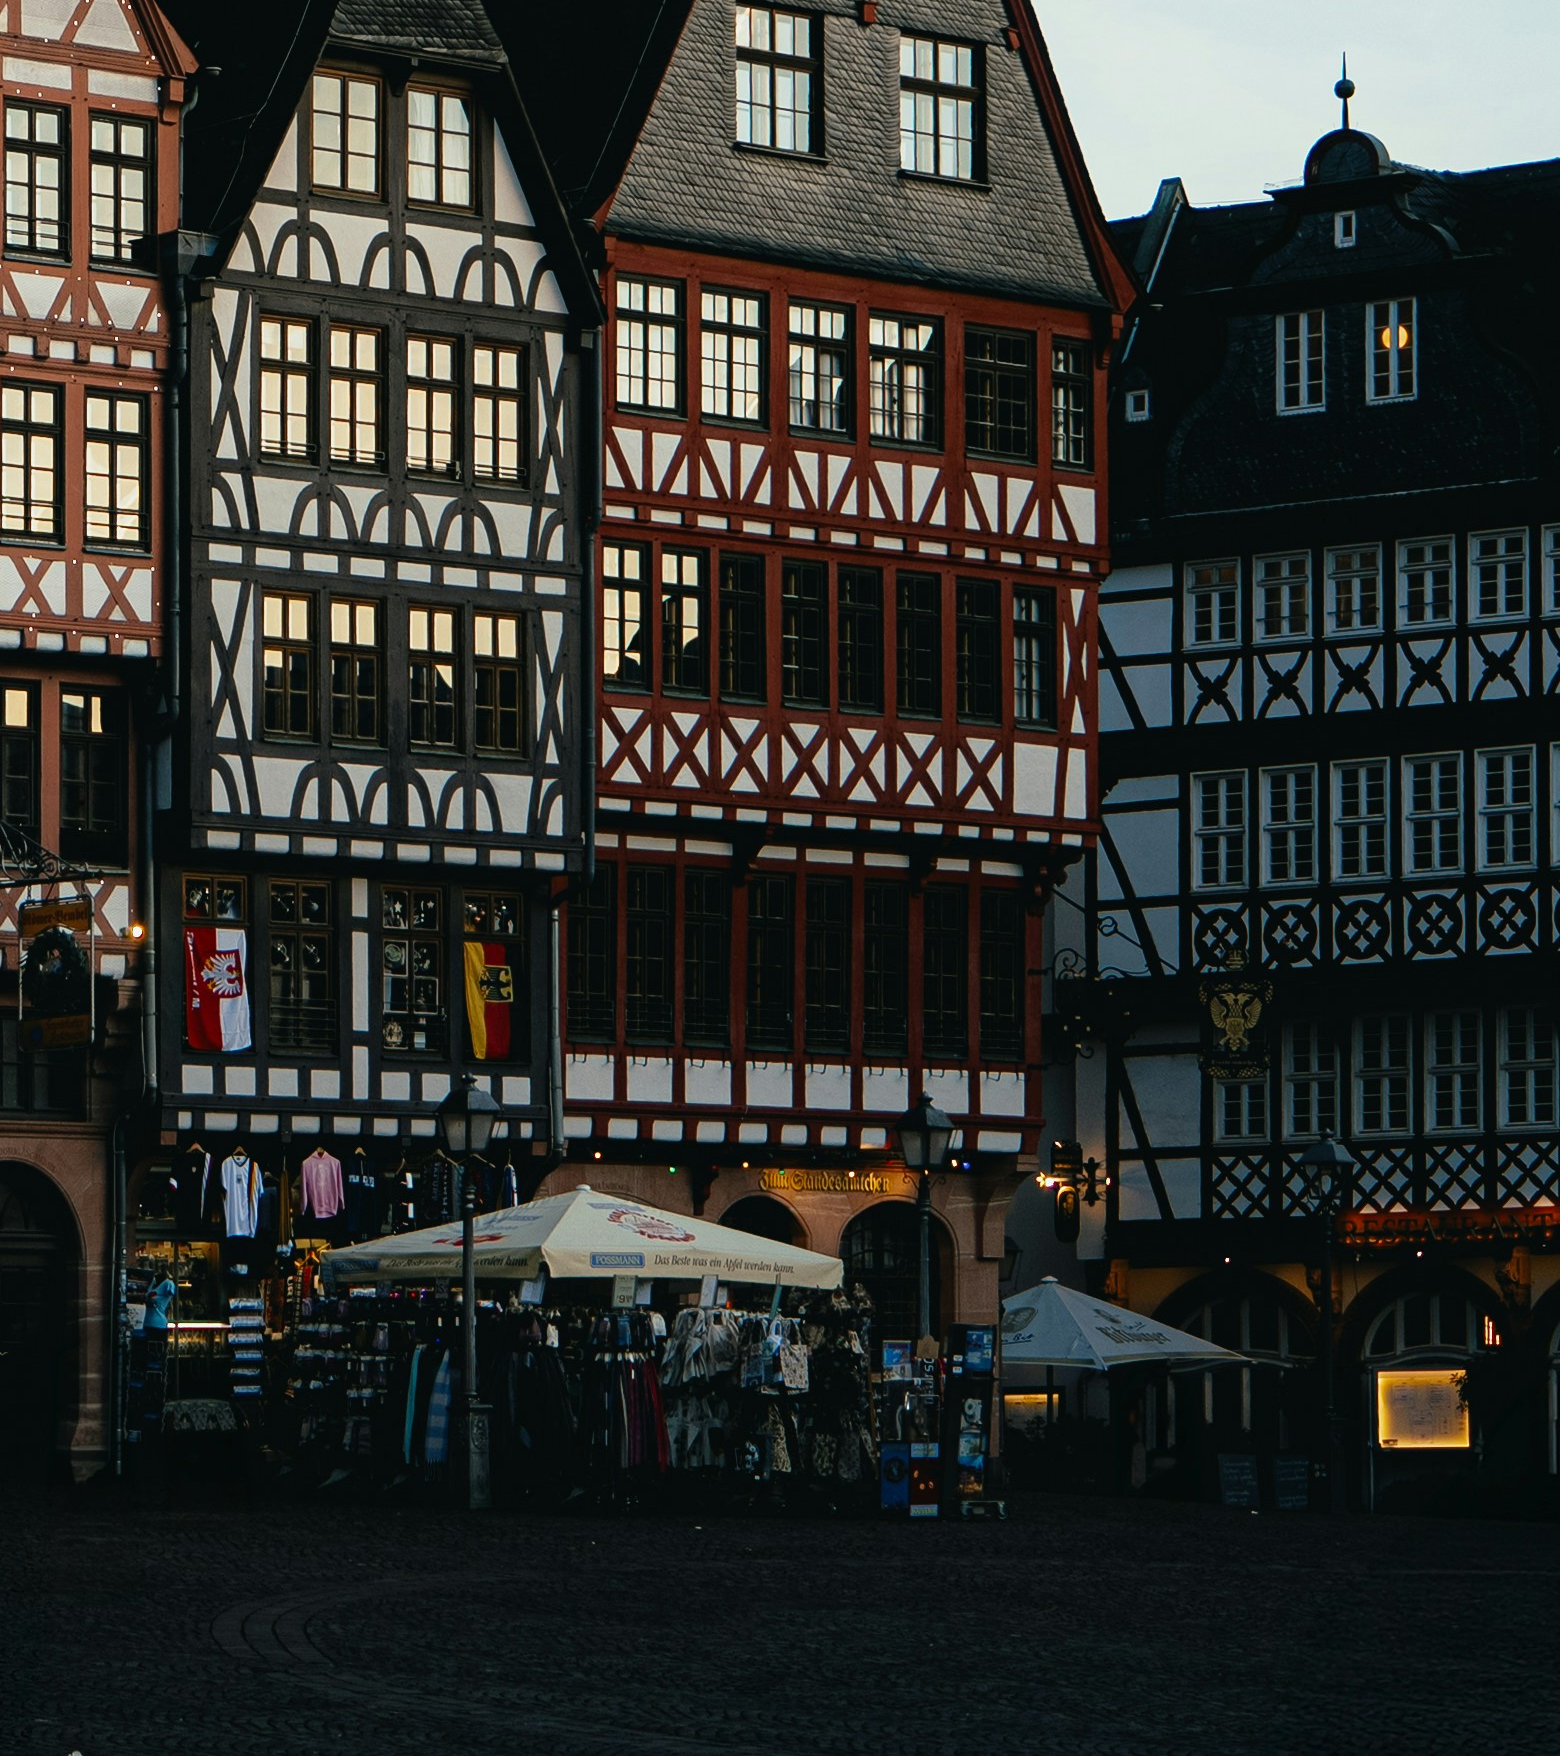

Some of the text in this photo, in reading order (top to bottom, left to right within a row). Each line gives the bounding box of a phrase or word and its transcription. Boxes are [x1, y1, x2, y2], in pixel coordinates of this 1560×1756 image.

[759, 1168, 789, 1191] Zum
[595, 1255, 641, 1266] POSSMANN
[654, 1255, 670, 1266] Das
[671, 1255, 691, 1267] Beste
[692, 1258, 708, 1267] was
[709, 1257, 722, 1268] ein
[723, 1258, 743, 1271] Apfel
[743, 1260, 772, 1272] werden
